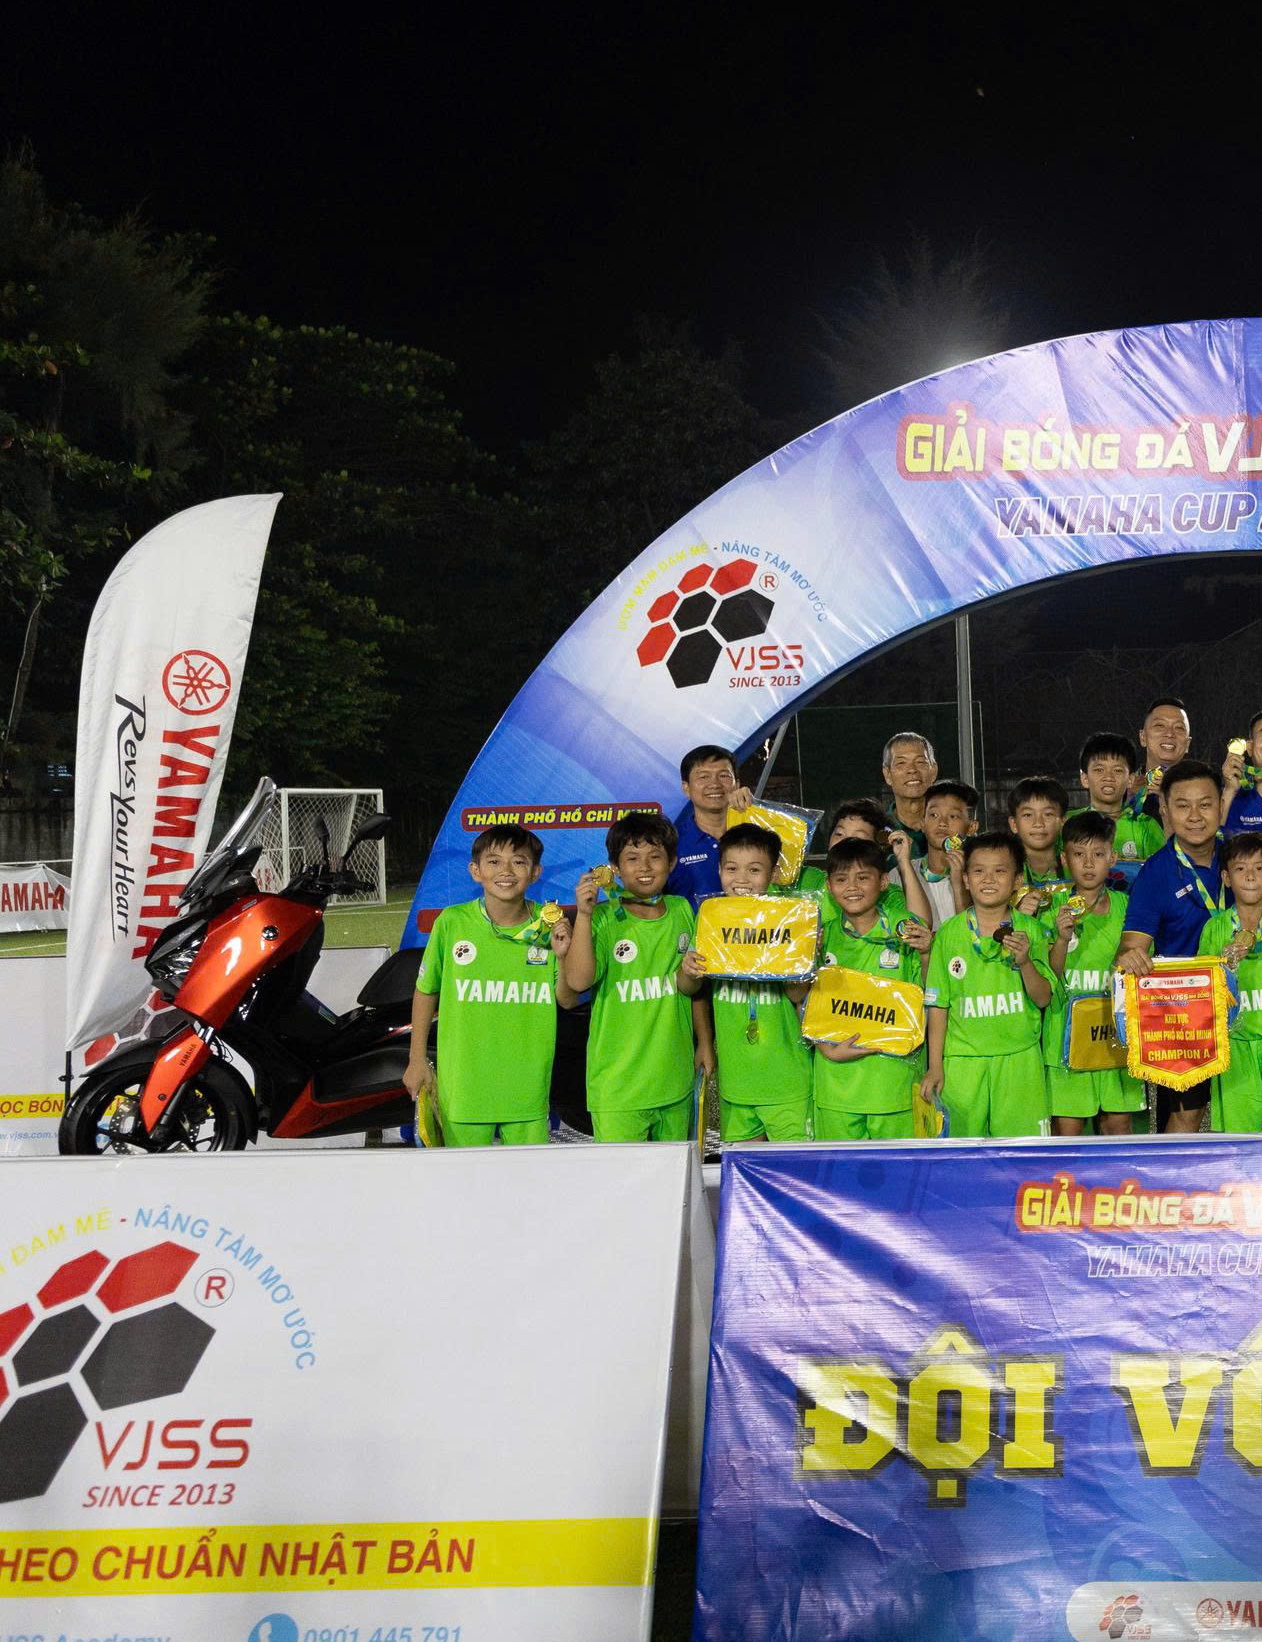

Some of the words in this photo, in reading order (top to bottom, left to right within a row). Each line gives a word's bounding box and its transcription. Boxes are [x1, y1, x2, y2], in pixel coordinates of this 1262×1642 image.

[904, 408, 986, 473] GIẢI
[1002, 418, 1121, 471] BÓNG
[1135, 421, 1194, 469] ĐÁ
[994, 493, 1163, 538] YAMAHA
[1170, 491, 1258, 534] CUP
[721, 540, 761, 558] NÂNG
[726, 644, 804, 671] VJSS
[729, 675, 766, 688] SINCE
[769, 674, 801, 687] 2013
[114, 694, 147, 791] Revs
[467, 810, 519, 826] THÀNH
[523, 808, 556, 824] PHỐ
[131, 724, 221, 960] YAMAHA
[115, 855, 135, 937] Heart
[455, 978, 552, 1004] YAMAHA
[831, 998, 896, 1025] YAMAHA
[959, 991, 1024, 1018] AMAH
[1148, 1049, 1201, 1062] CHAMPION
[1021, 1177, 1083, 1226] GIẢI
[1092, 1184, 1182, 1226] BÓNG
[1087, 1243, 1213, 1278] YAMAHA
[134, 1204, 210, 1239] NÂNG
[257, 1264, 295, 1305] MƠ
[283, 1306, 317, 1371] ƯỚC
[800, 1328, 1060, 1502] ĐỘI
[95, 1418, 253, 1471] VJSS
[82, 1485, 166, 1508] SINCE
[168, 1482, 237, 1507] 2013
[92, 1527, 247, 1583] CHUẨN
[258, 1530, 378, 1586] NHẬT
[386, 1527, 476, 1576] BẢN
